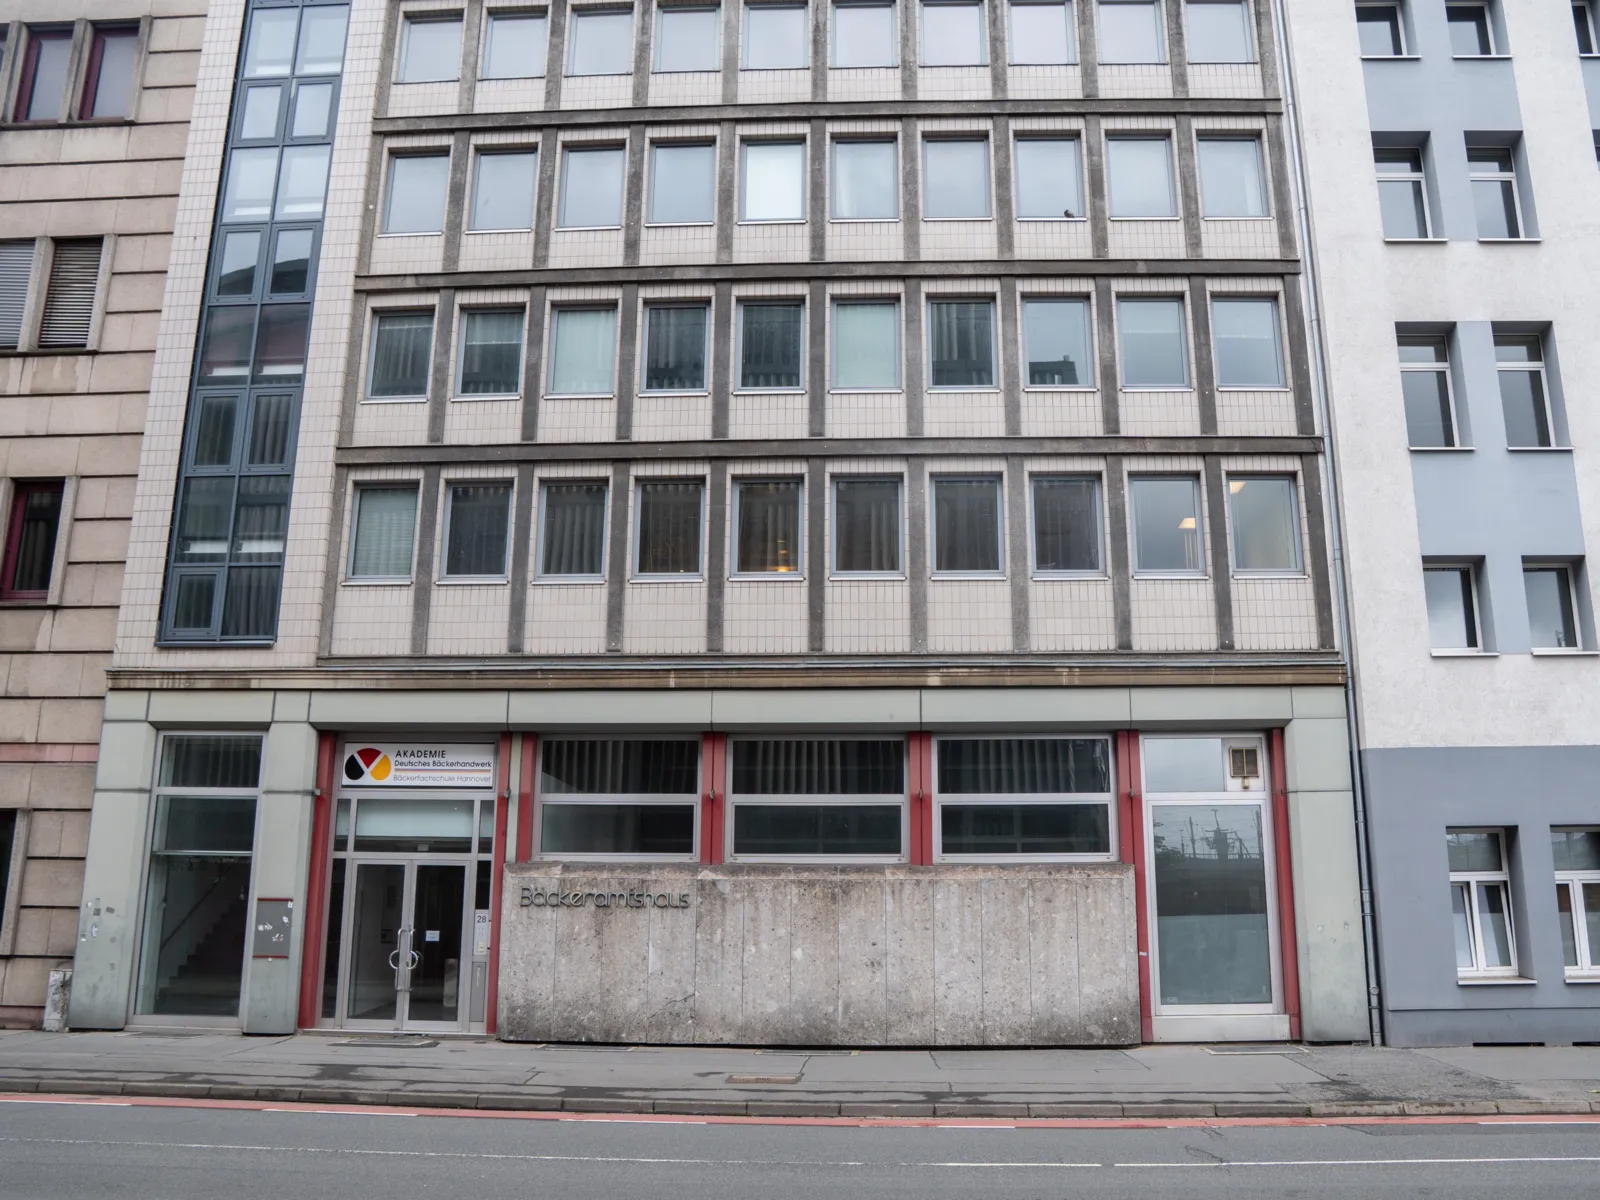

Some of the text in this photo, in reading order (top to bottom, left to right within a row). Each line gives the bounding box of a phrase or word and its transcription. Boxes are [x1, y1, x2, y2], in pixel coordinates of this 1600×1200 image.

[395, 750, 446, 758] AKADEMIE
[432, 760, 492, 768] Bäckerhandwerk
[393, 774, 491, 783] Bäckerfachschule Hannover
[519, 887, 690, 908] Bäckeramtshaus
[477, 915, 487, 923] 28
